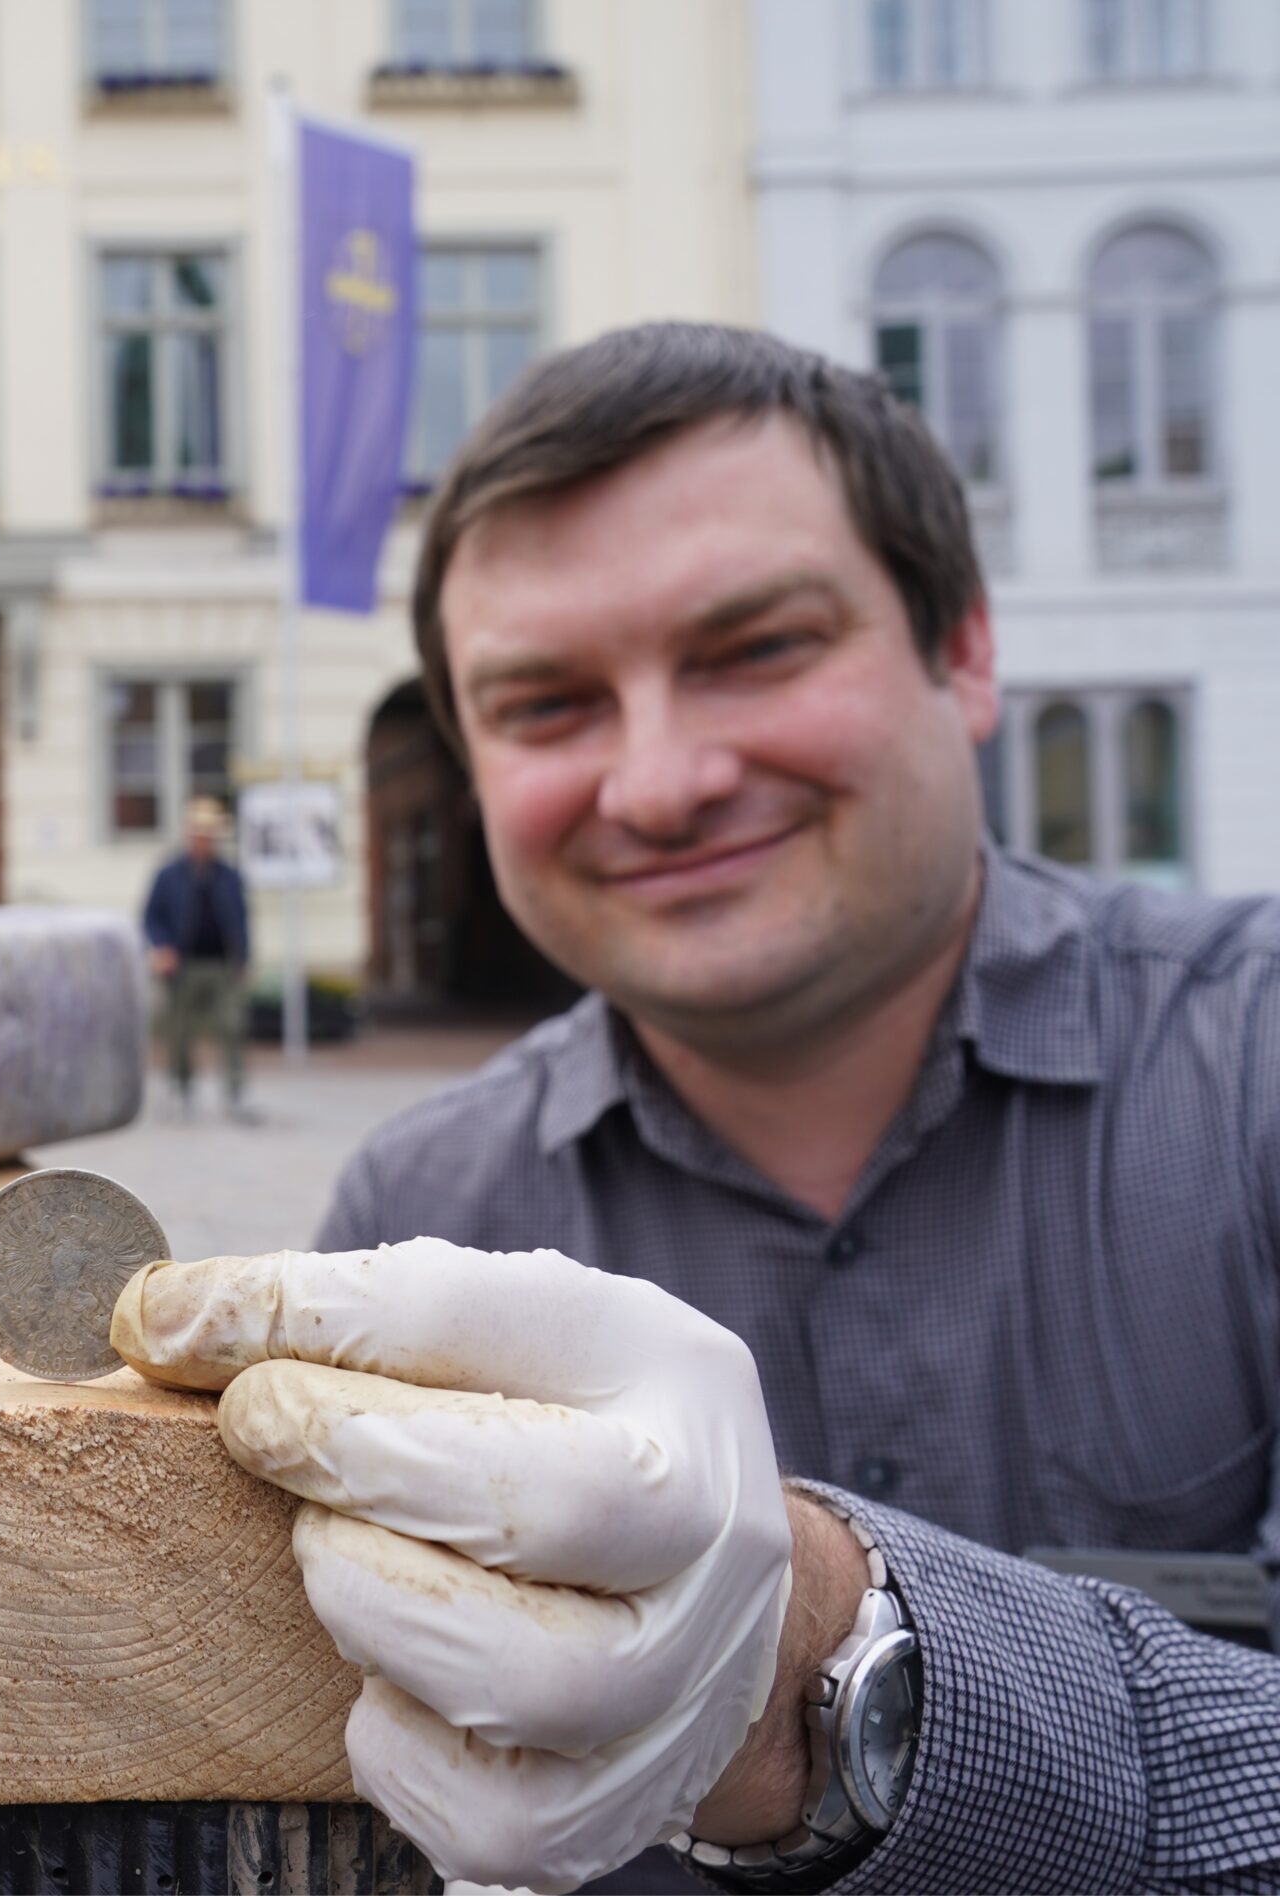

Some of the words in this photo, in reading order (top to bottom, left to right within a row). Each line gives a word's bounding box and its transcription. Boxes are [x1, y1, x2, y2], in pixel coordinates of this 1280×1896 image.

[88, 1184, 133, 1217] XXX
[132, 1214, 161, 1249] EIN
[25, 1350, 77, 1372] 1867
